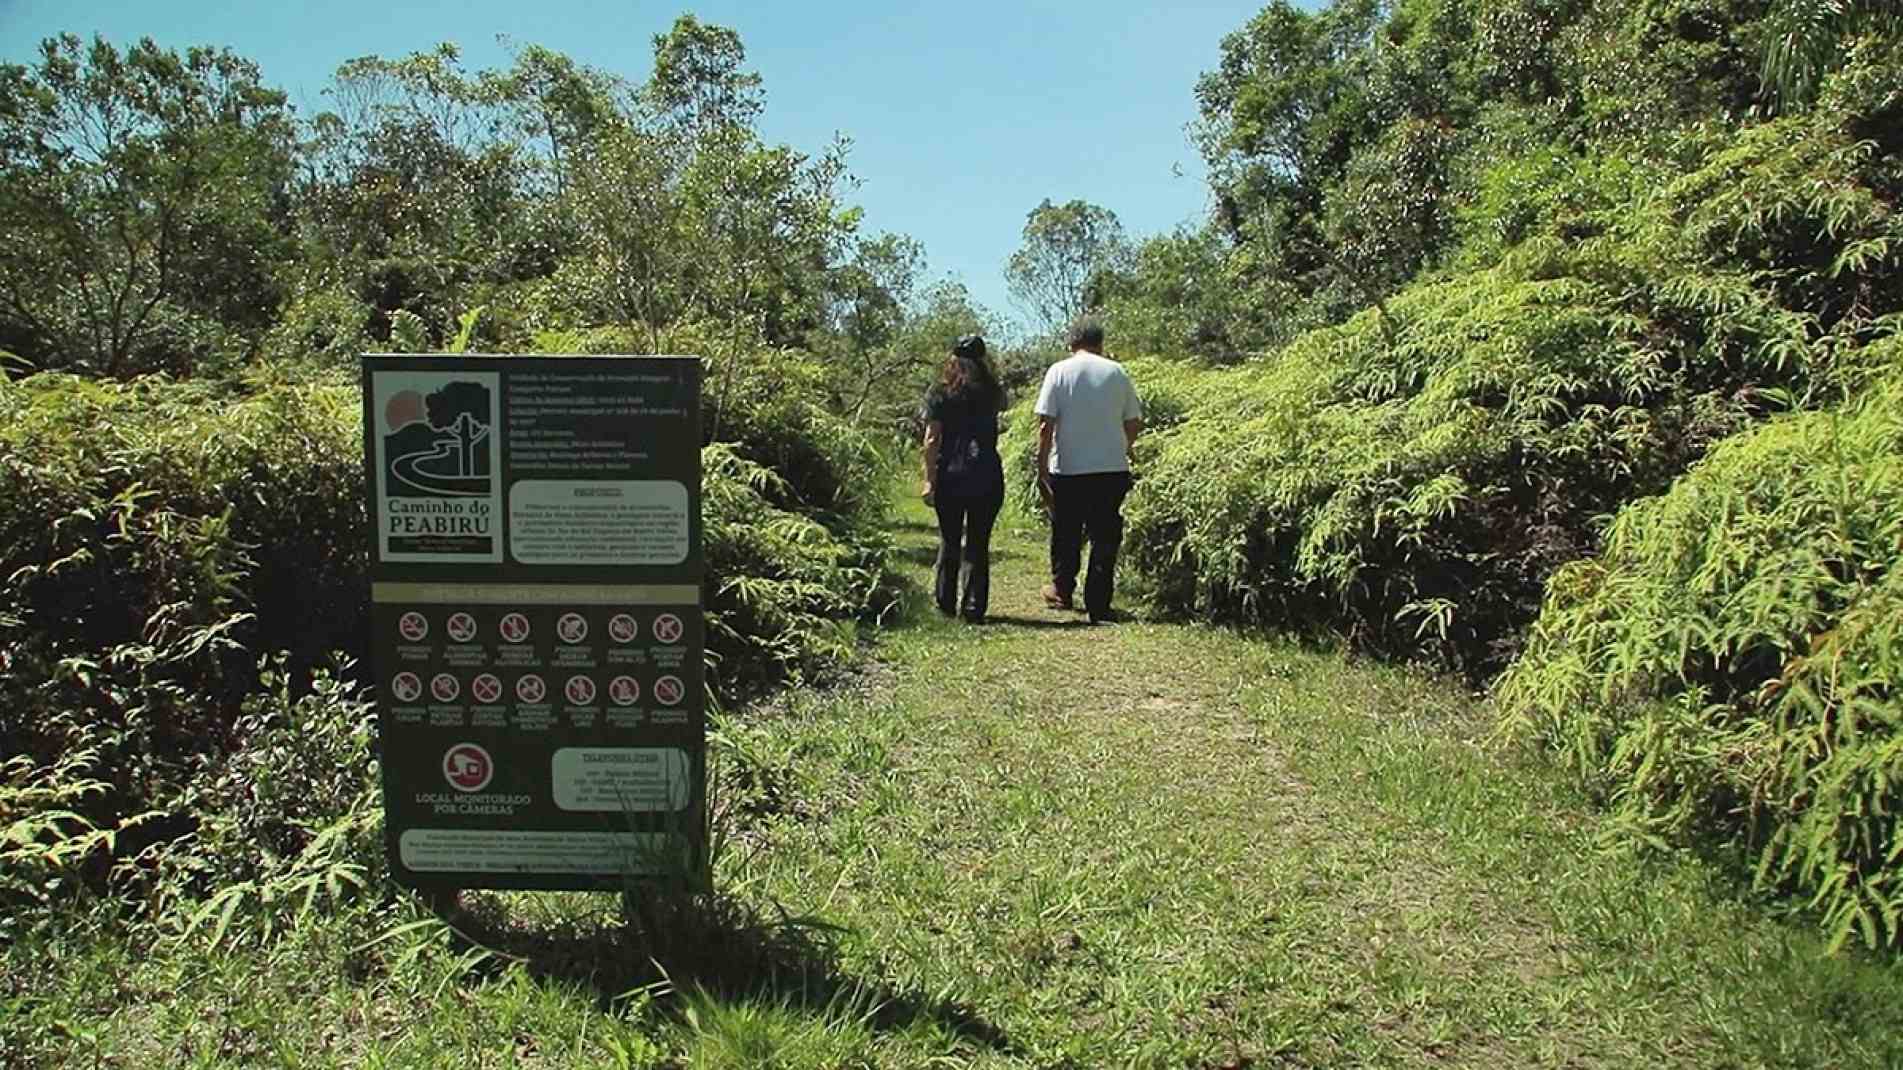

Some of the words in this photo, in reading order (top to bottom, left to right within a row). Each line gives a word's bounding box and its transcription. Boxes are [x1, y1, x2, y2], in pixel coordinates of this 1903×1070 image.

[388, 499, 464, 514] Caminho
[469, 499, 491, 514] do
[415, 793, 451, 803] LOCAL
[454, 794, 532, 805] MONITORADO
[433, 804, 457, 814] POR
